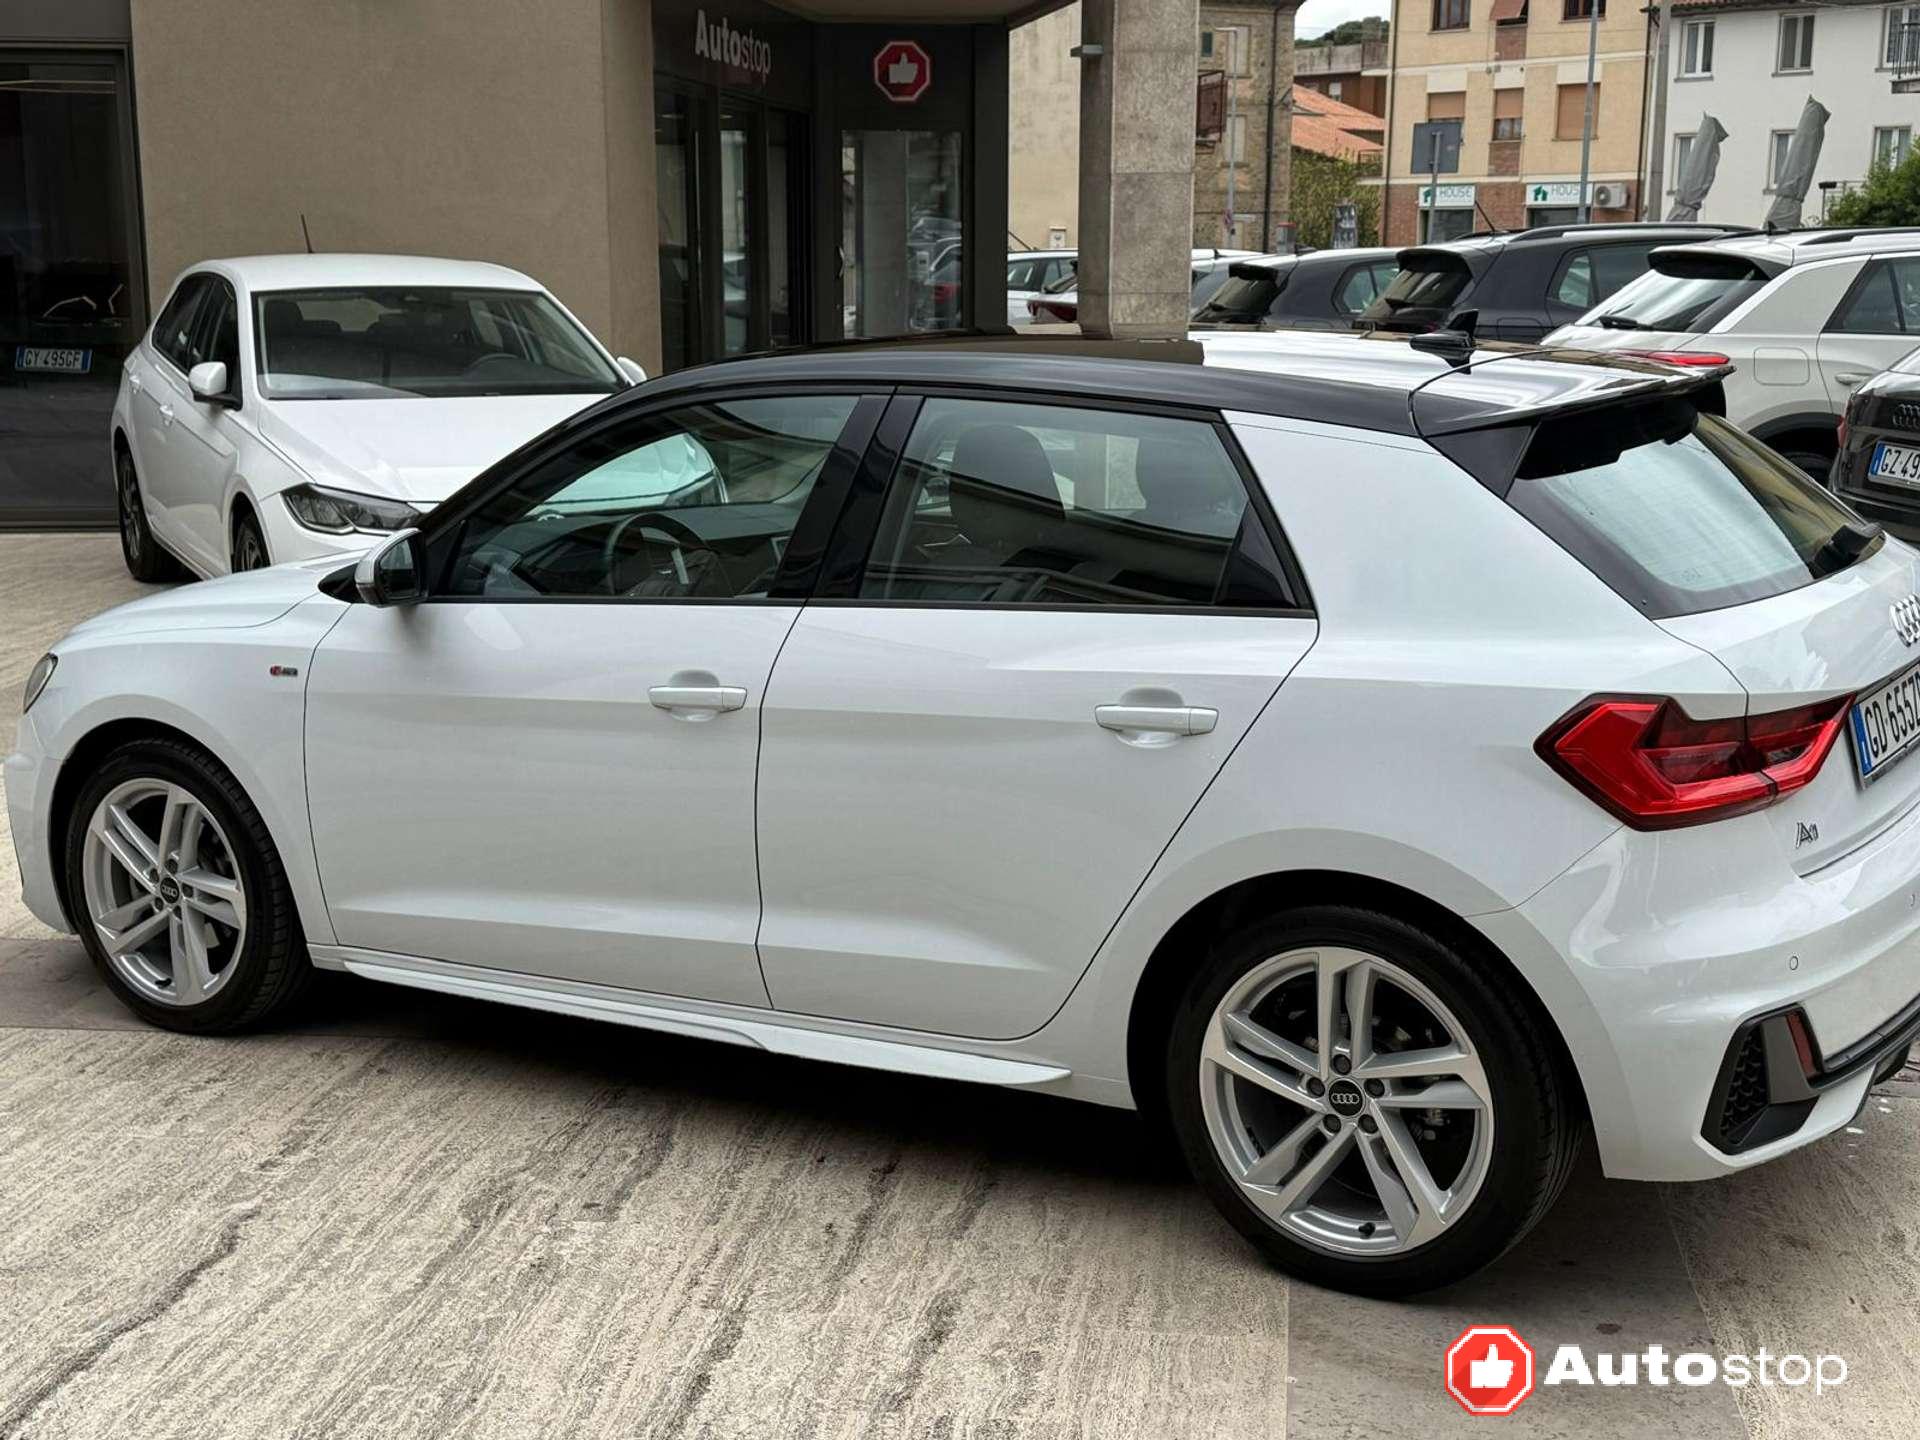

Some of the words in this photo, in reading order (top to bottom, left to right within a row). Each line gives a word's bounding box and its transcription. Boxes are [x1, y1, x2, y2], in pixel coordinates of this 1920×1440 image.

[694, 9, 771, 84] Autostop
[1439, 186, 1472, 198] HOUSE
[1551, 184, 1581, 197] HOUS
[25, 350, 40, 366] GY
[1880, 448, 1902, 475] GZ
[1900, 451, 1920, 481] 49
[1864, 700, 1888, 759] GD
